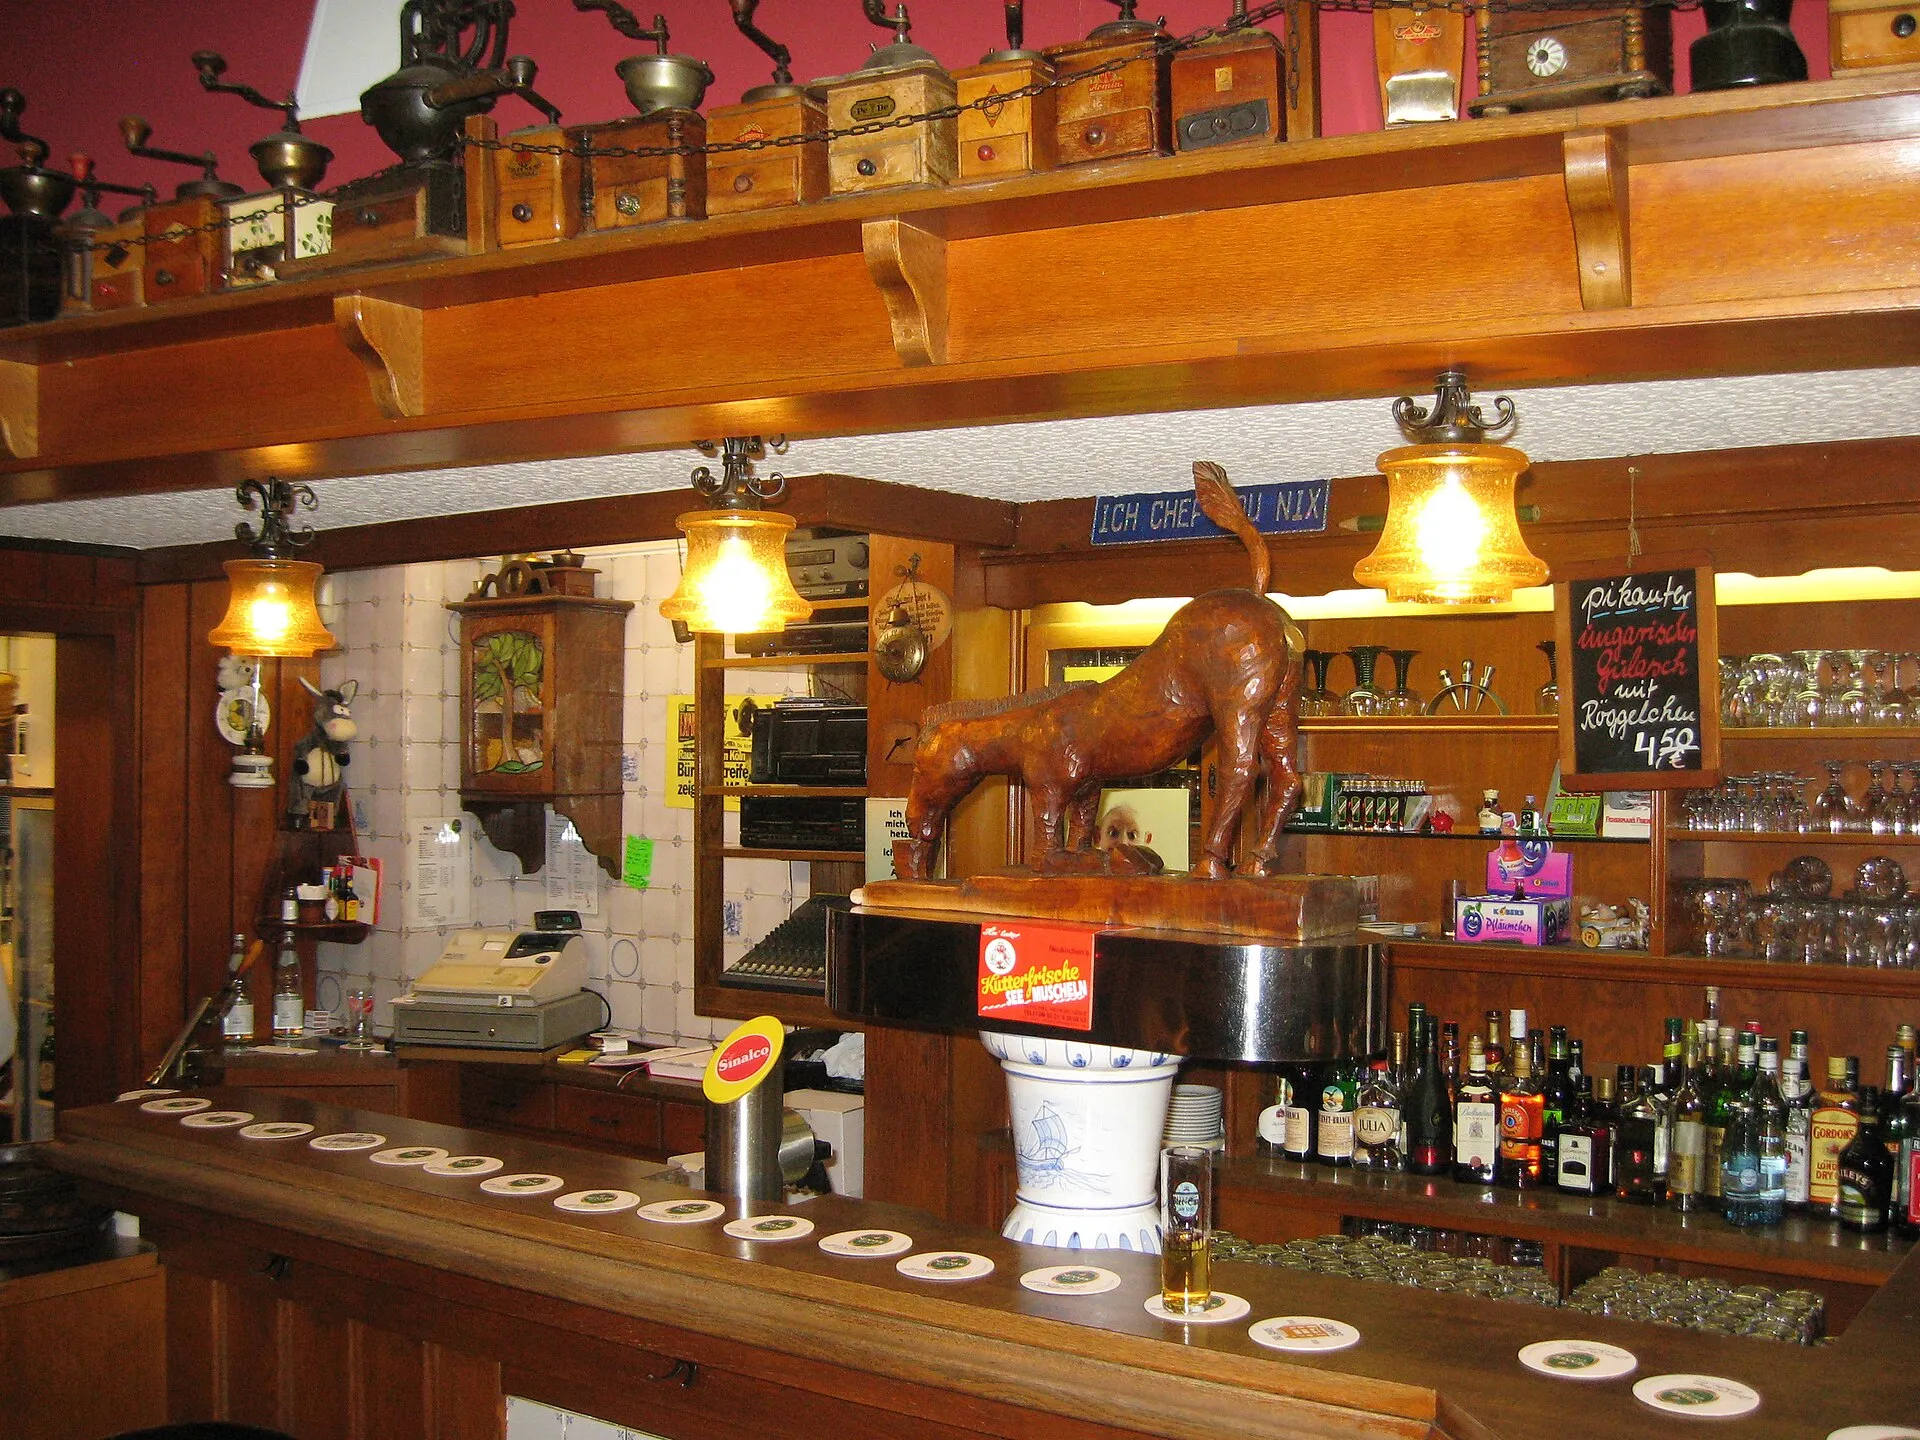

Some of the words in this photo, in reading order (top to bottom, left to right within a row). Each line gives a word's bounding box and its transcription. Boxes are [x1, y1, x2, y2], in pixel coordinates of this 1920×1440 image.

[1098, 502, 1140, 533] ICH
[1275, 487, 1322, 521] NIX
[889, 810, 902, 818] Ich
[981, 959, 1080, 999] Kutterfrische
[1005, 988, 1025, 1006] SEE
[1031, 979, 1088, 1002] MUSCHELN
[718, 1046, 770, 1072] Sinalco
[1360, 1119, 1386, 1132] JULIA
[1816, 1160, 1838, 1170] LOND
[1815, 1170, 1834, 1180] DRY
[1840, 1168, 1869, 1186] ILEYS
